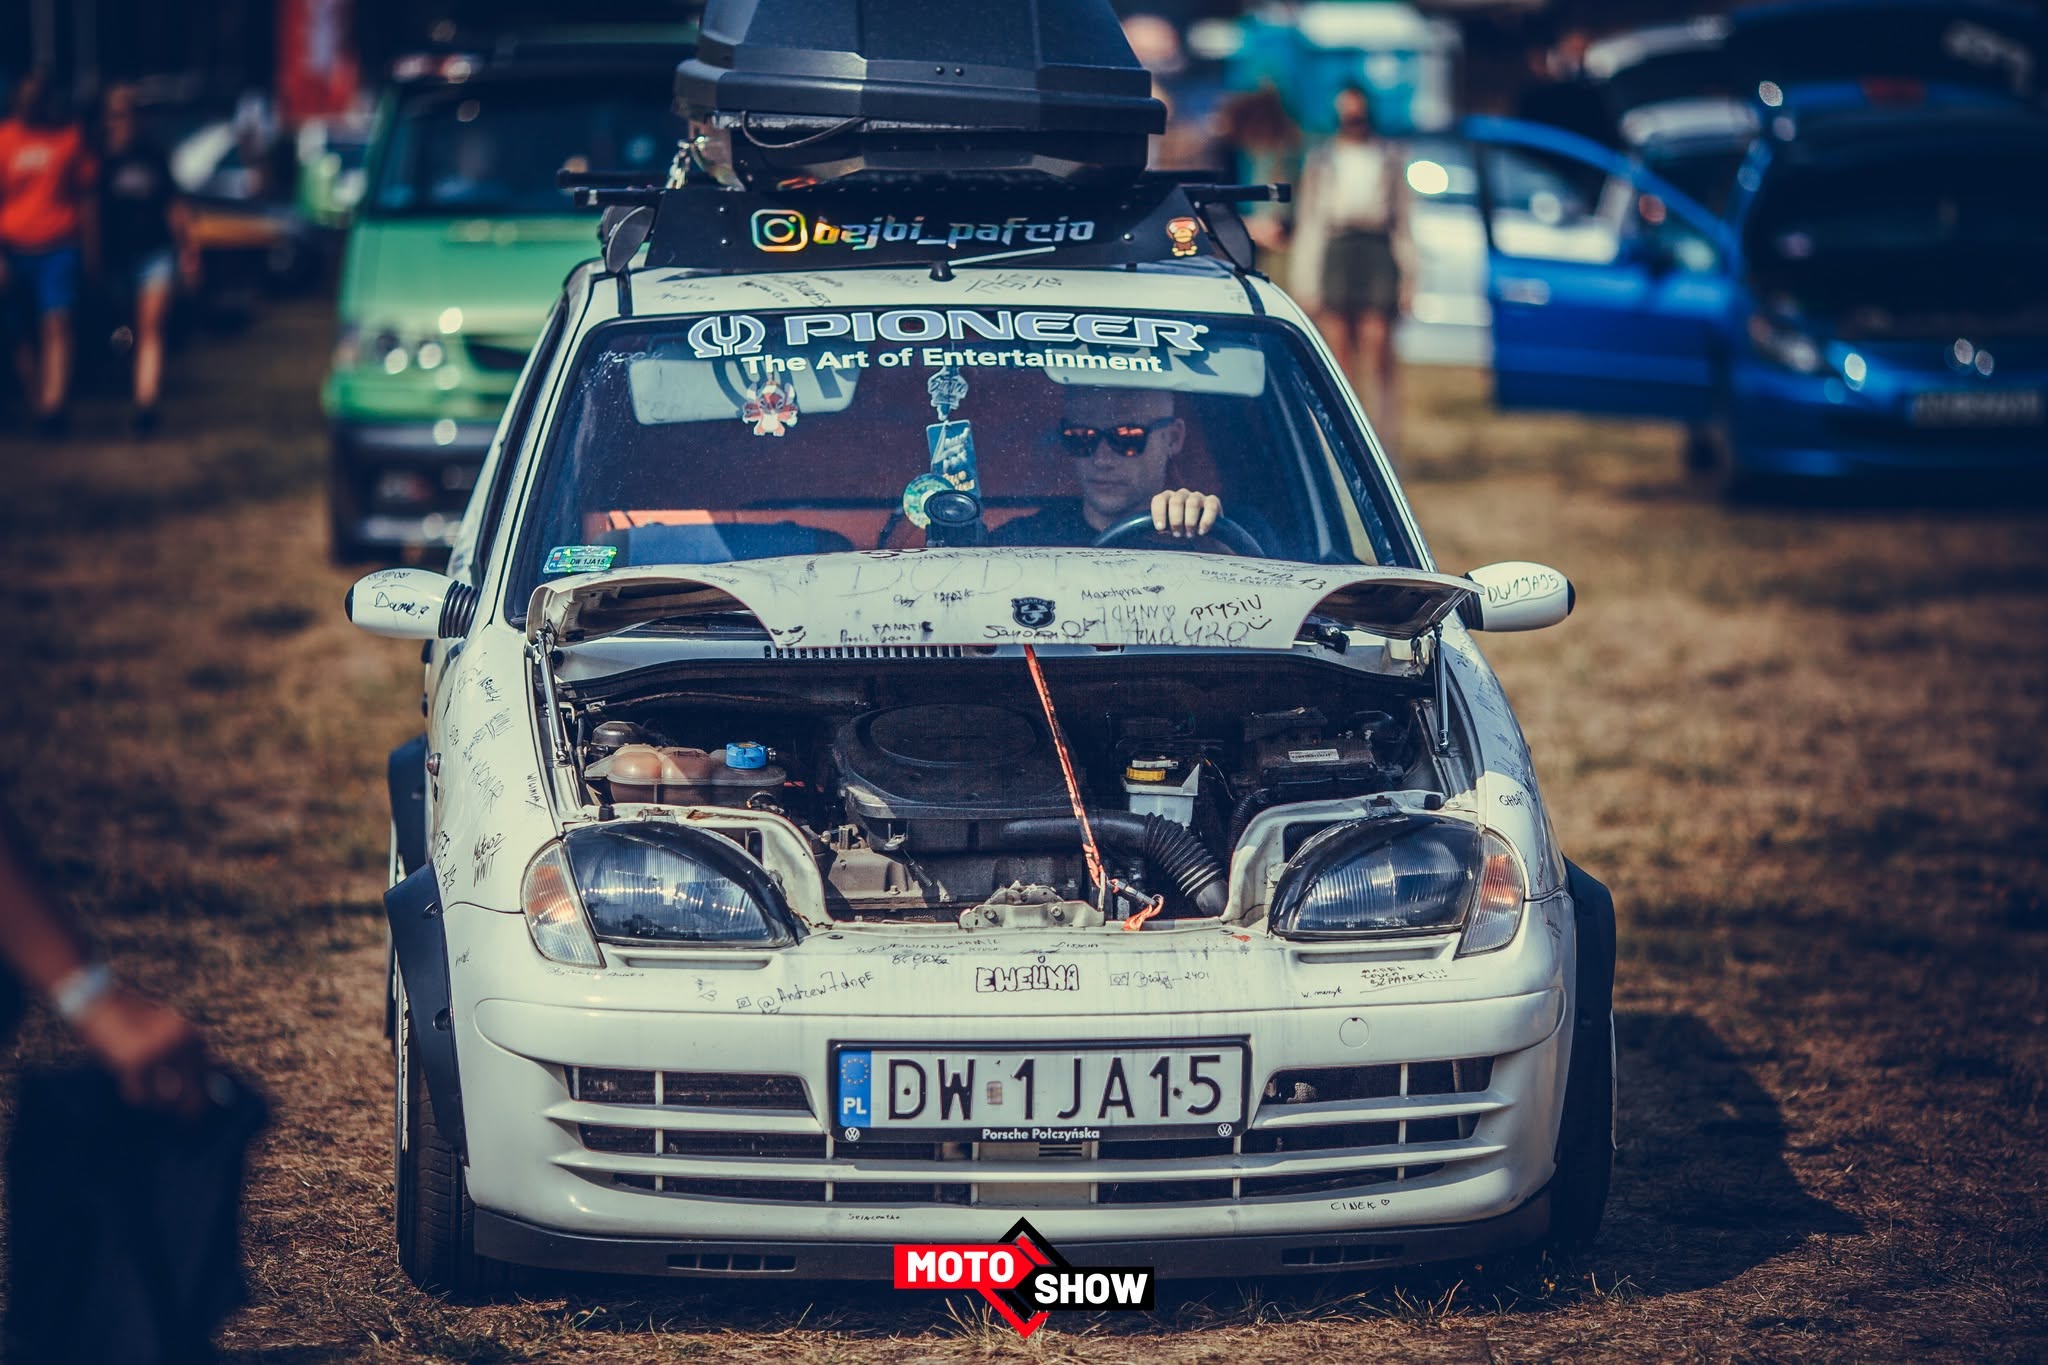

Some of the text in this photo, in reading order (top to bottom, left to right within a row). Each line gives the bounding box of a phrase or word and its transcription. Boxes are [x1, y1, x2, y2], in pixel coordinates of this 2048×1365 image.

[813, 216, 1095, 250] bejbi_pafcio
[783, 309, 1205, 352] PIONEER
[742, 346, 1163, 374] The Art of Entertainment
[888, 1054, 1222, 1121] DW 1JA15
[843, 1097, 867, 1115] PL
[982, 1127, 1100, 1142] Porsche Połczyńska
